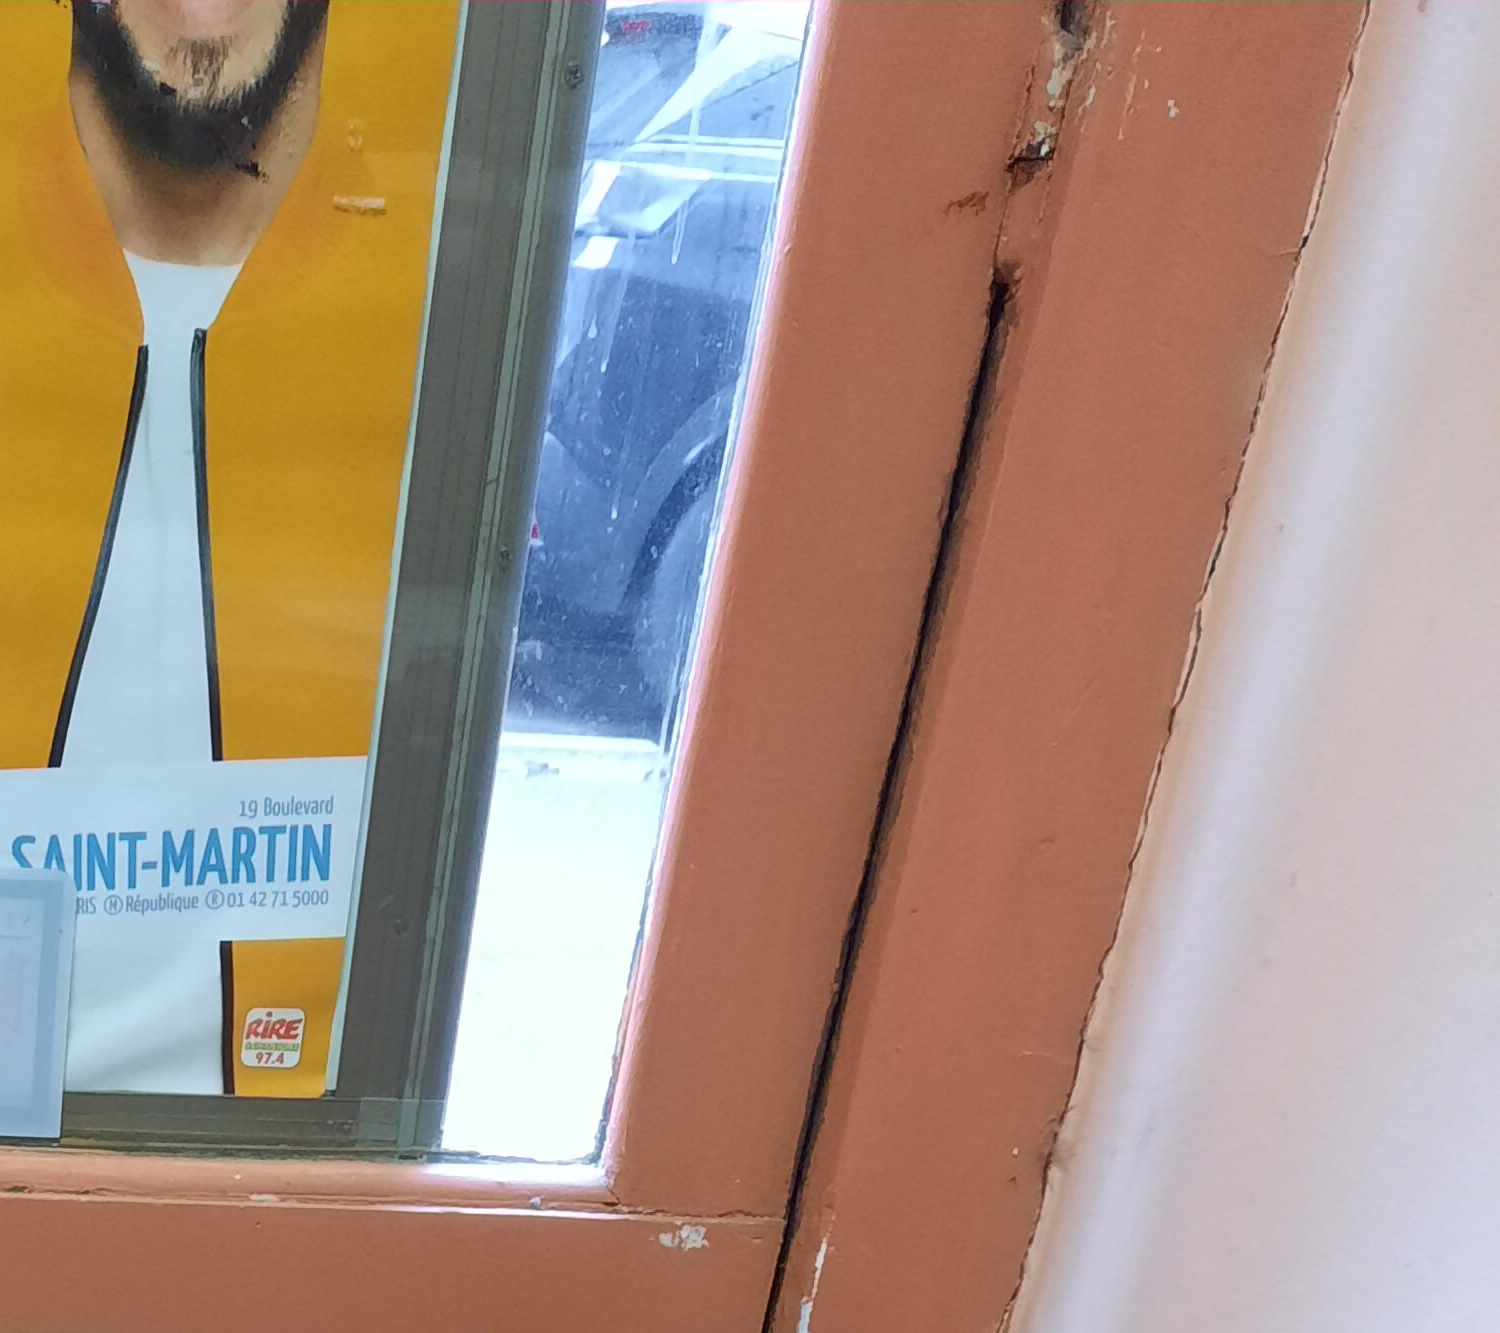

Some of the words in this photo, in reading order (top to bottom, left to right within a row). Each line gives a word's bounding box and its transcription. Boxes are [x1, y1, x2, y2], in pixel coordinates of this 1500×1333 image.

[238, 799, 258, 819] 19
[263, 794, 334, 817] Boulevard
[125, 893, 199, 917] République
[226, 892, 244, 908] 01
[248, 892, 267, 908] 42
[271, 891, 287, 907] 71
[291, 889, 329, 908] 5000
[255, 1052, 284, 1065] 97.4
